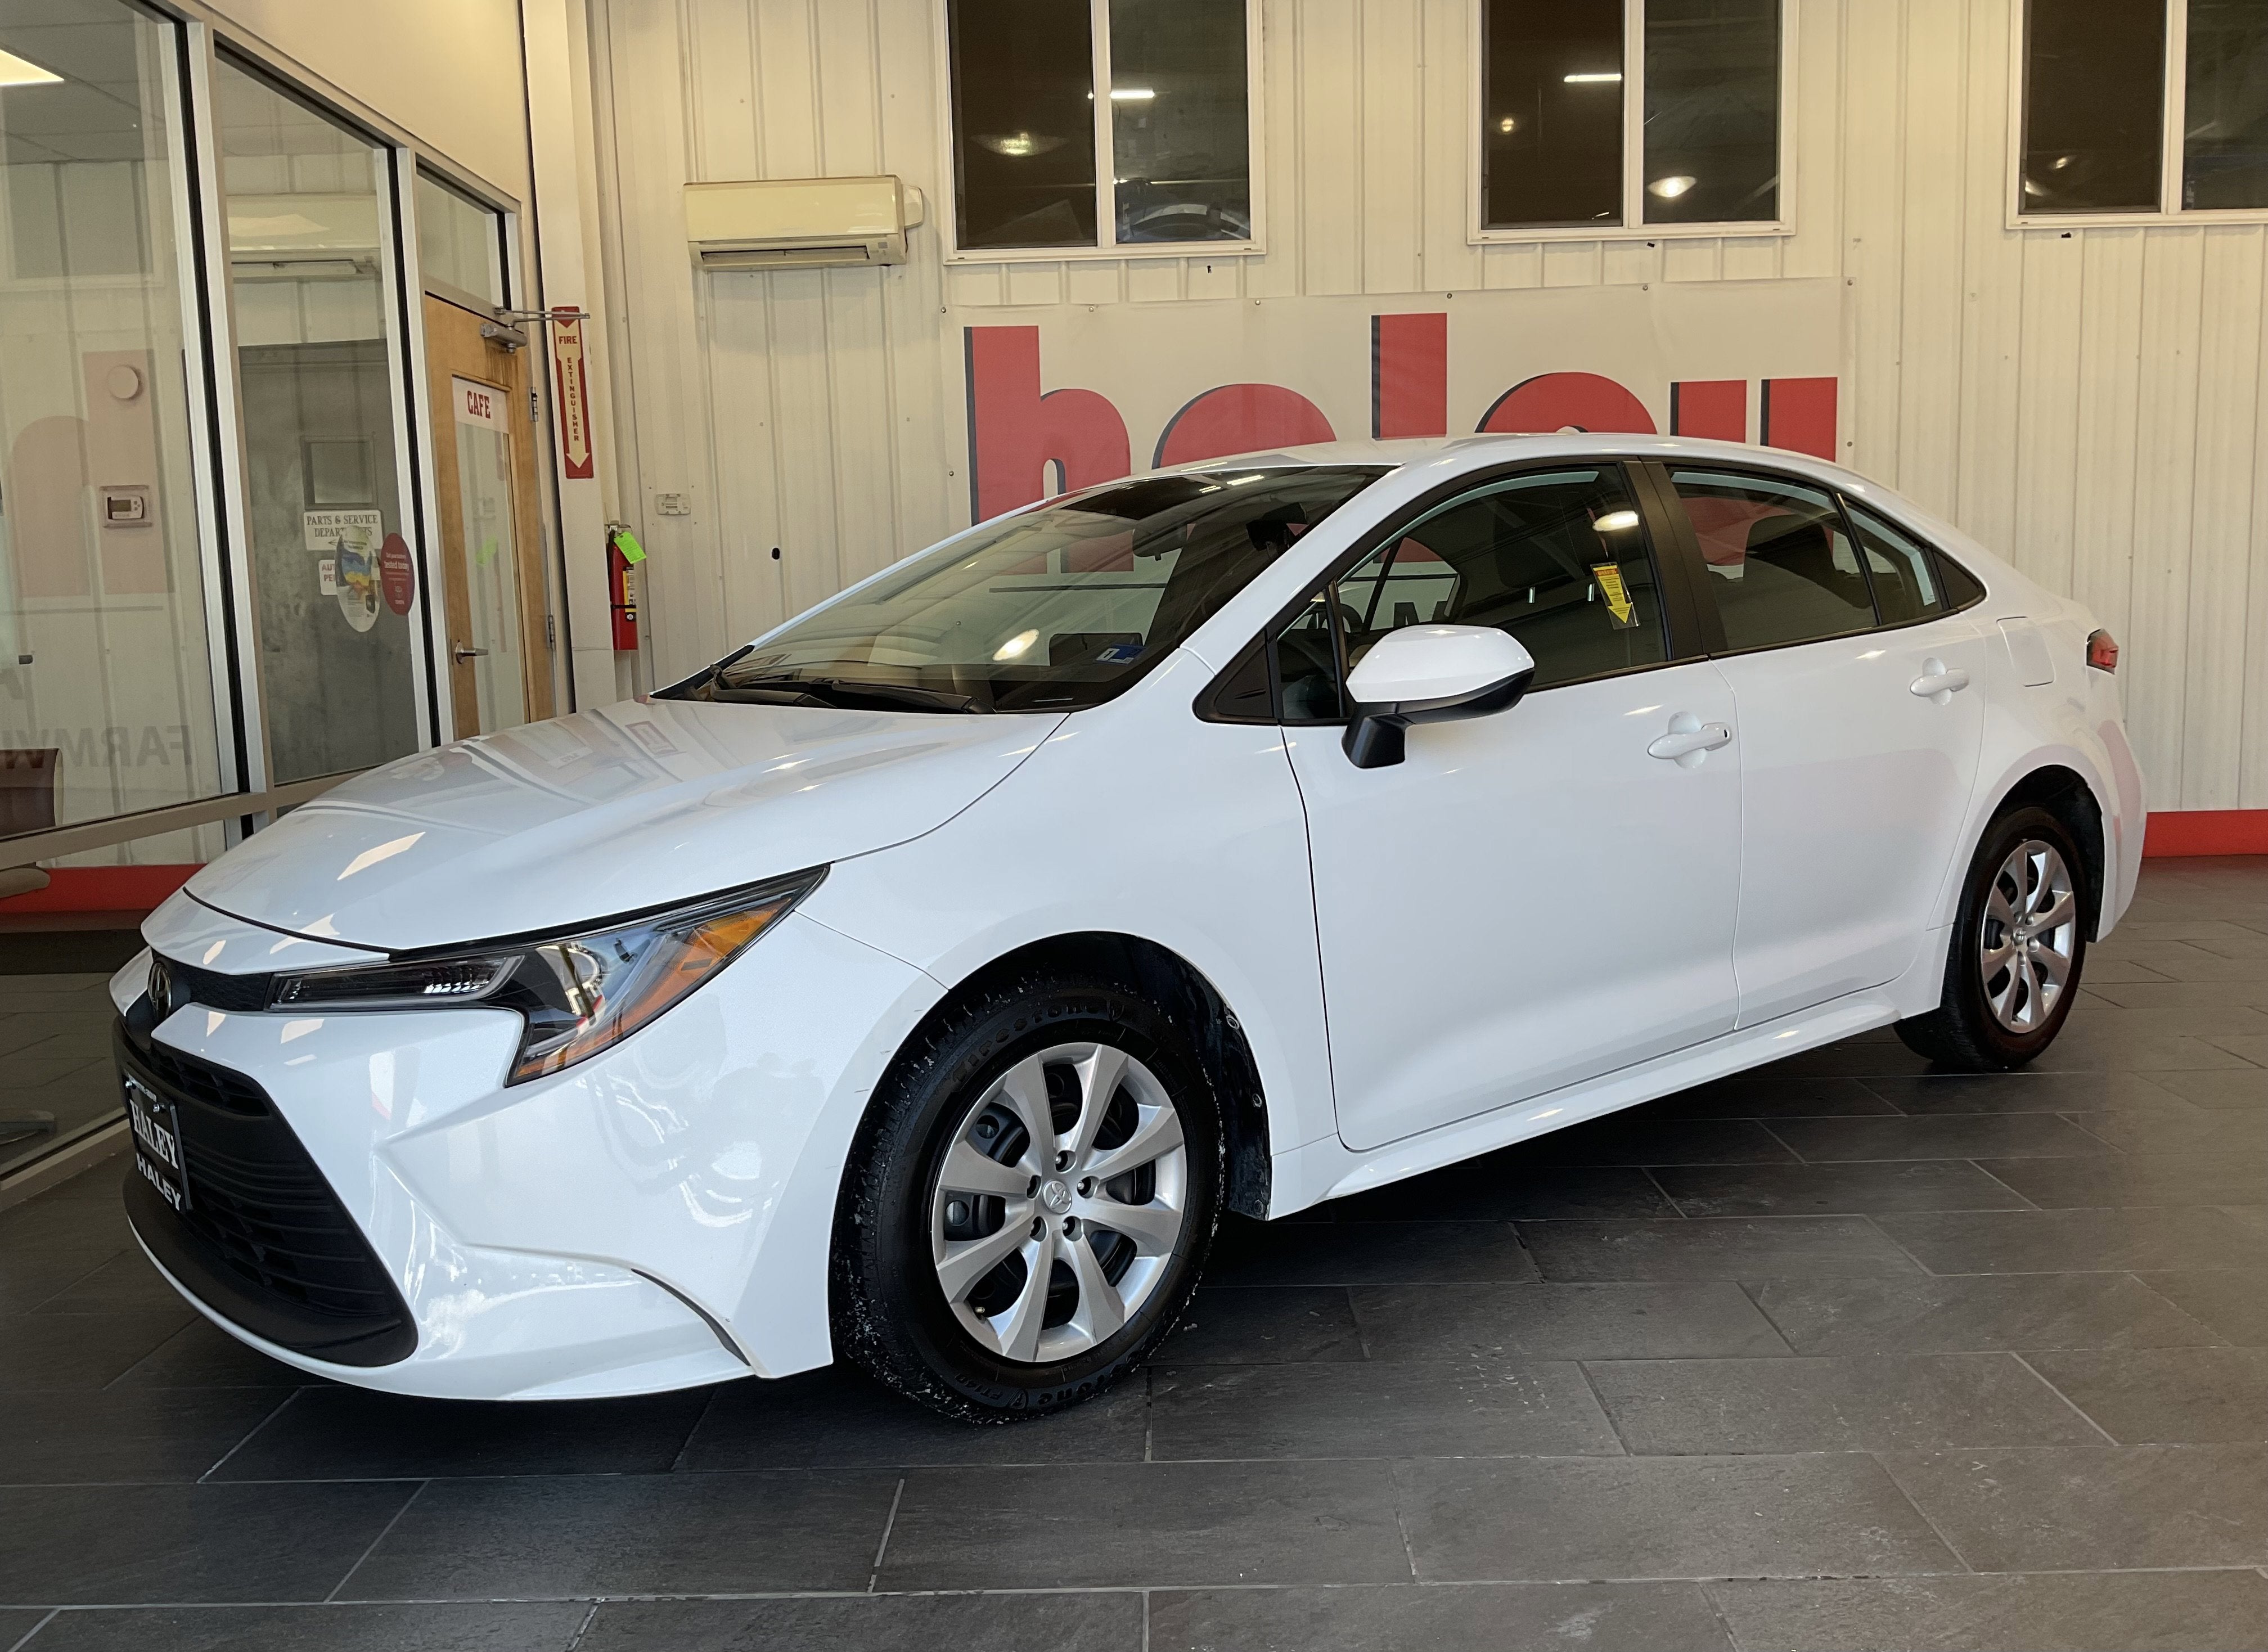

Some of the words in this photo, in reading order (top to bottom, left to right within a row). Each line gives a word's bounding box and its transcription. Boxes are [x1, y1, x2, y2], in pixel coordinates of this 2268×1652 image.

[559, 335, 578, 344] FIRE
[467, 390, 491, 419] CAFE
[567, 357, 579, 442] EXTINGUISHER
[307, 516, 332, 525] PARTS
[335, 515, 341, 524] &
[344, 515, 378, 524] SERVICE
[130, 1099, 179, 1169] HALEY
[136, 1152, 181, 1211] HALEY
